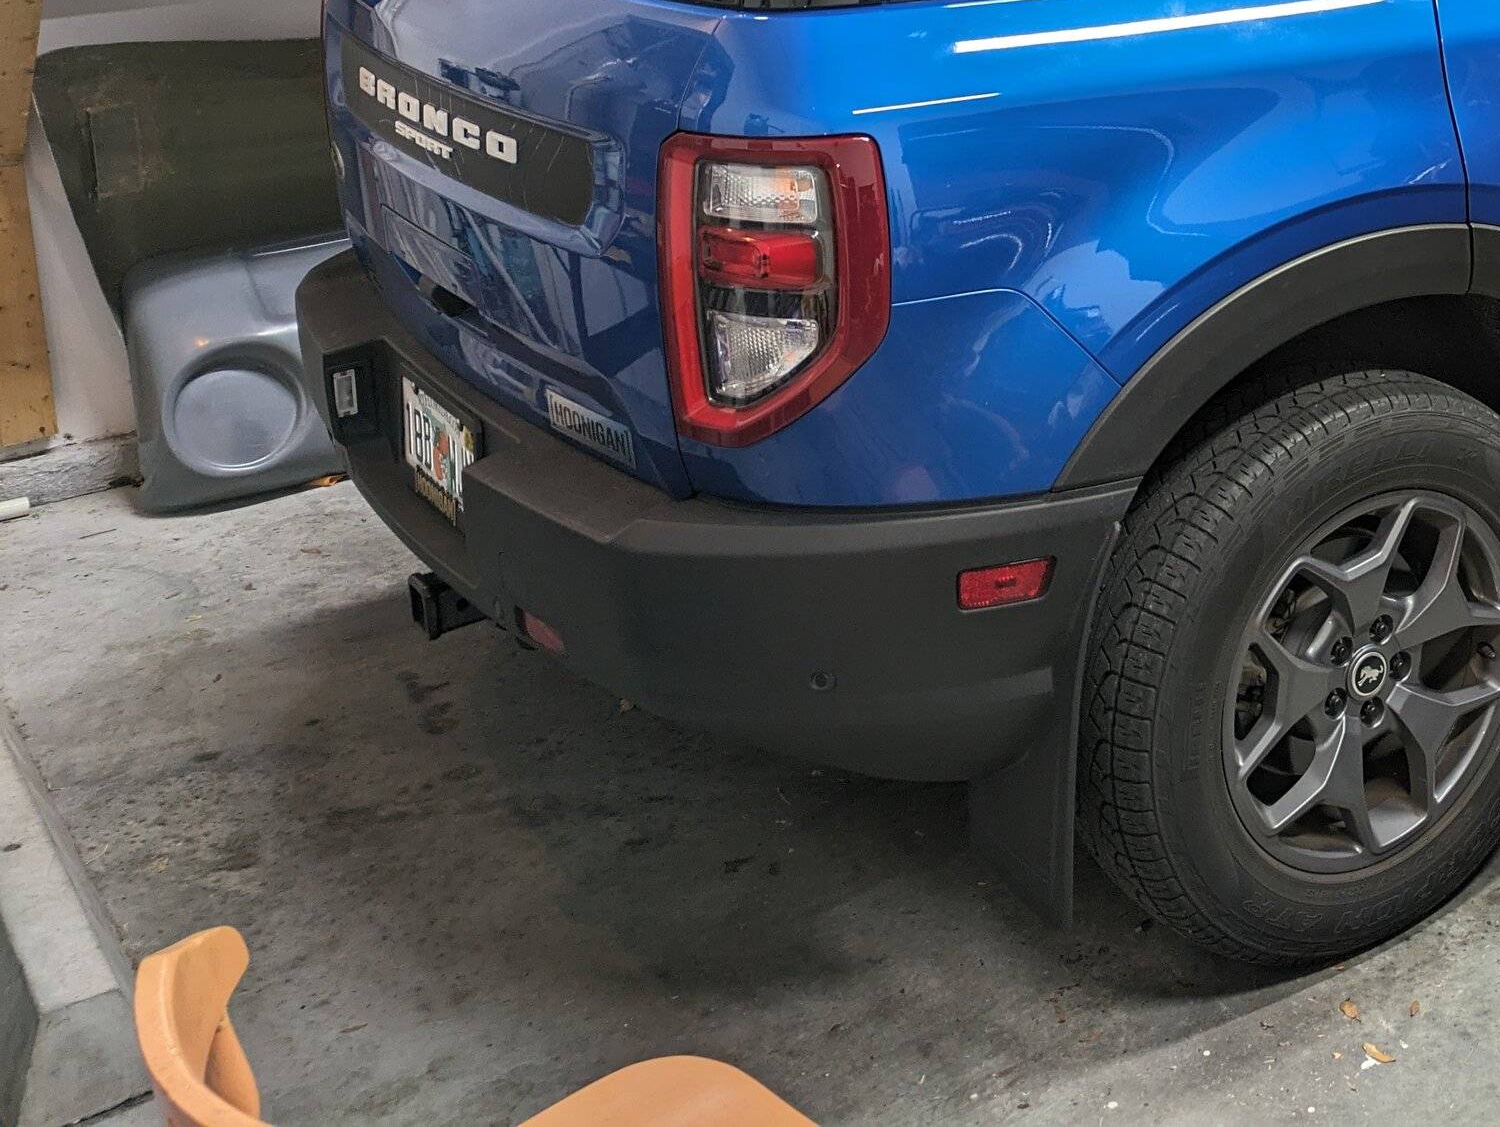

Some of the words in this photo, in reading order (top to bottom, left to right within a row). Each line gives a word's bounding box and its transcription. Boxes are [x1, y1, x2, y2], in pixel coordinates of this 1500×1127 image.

[358, 65, 519, 165] BRONCO
[394, 119, 454, 160] SPORT
[553, 400, 629, 460] HOONIGAN
